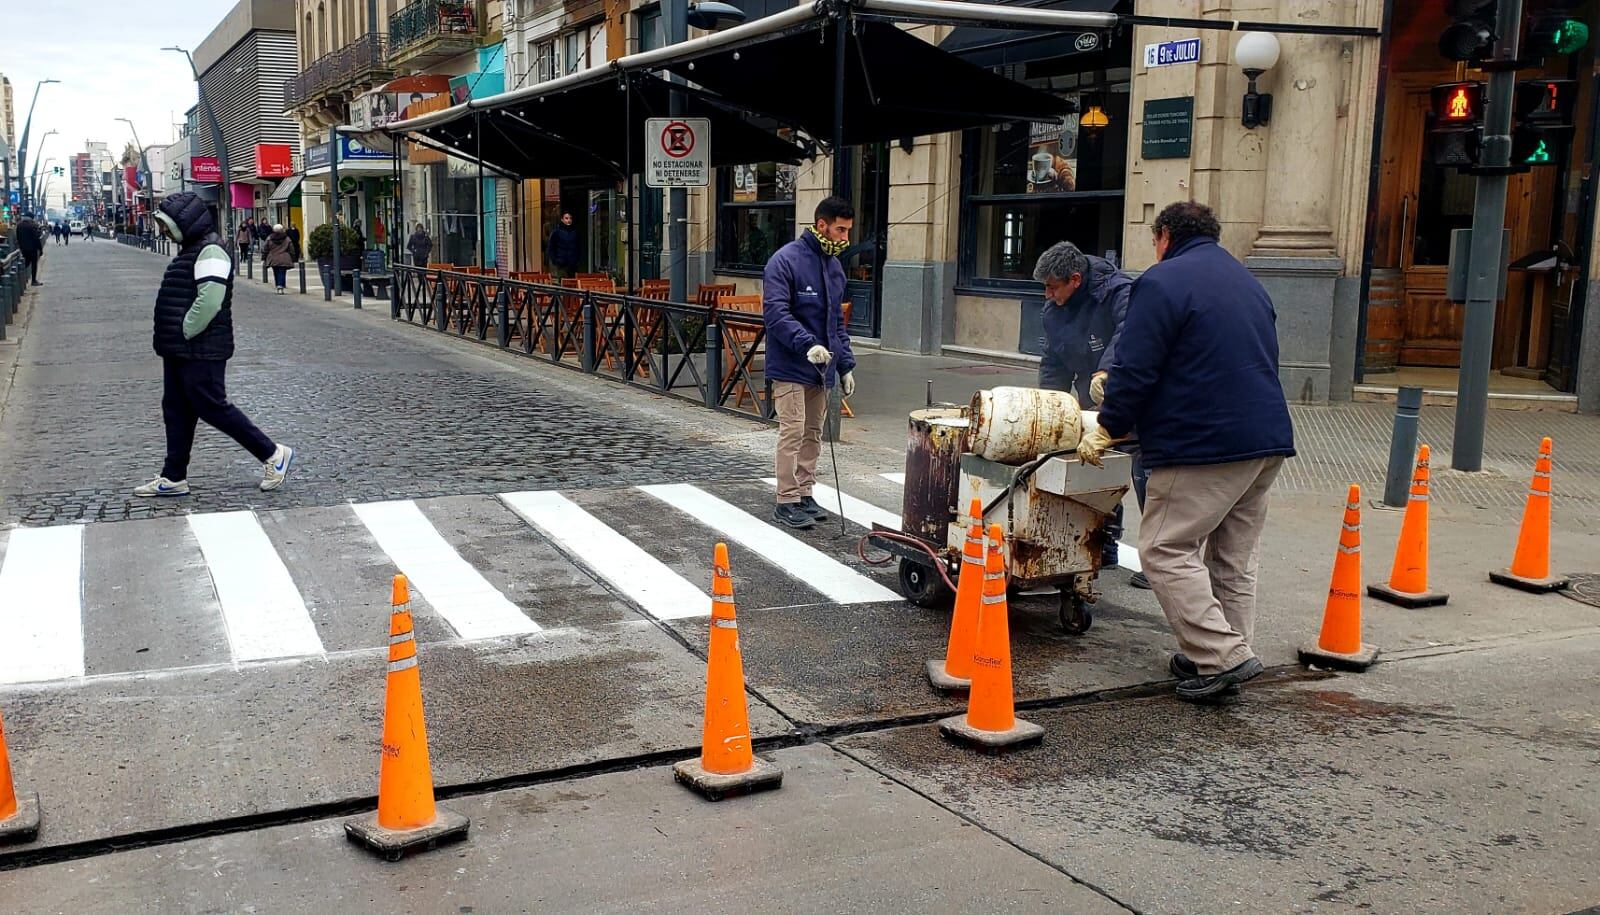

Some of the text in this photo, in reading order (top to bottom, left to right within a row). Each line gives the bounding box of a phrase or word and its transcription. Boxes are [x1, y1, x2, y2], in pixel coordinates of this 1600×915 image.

[1147, 42, 1196, 65] 16 9 DE JULIO
[652, 160, 704, 169] NO ESTACIONAR
[655, 169, 701, 178] NI DETENERSE
